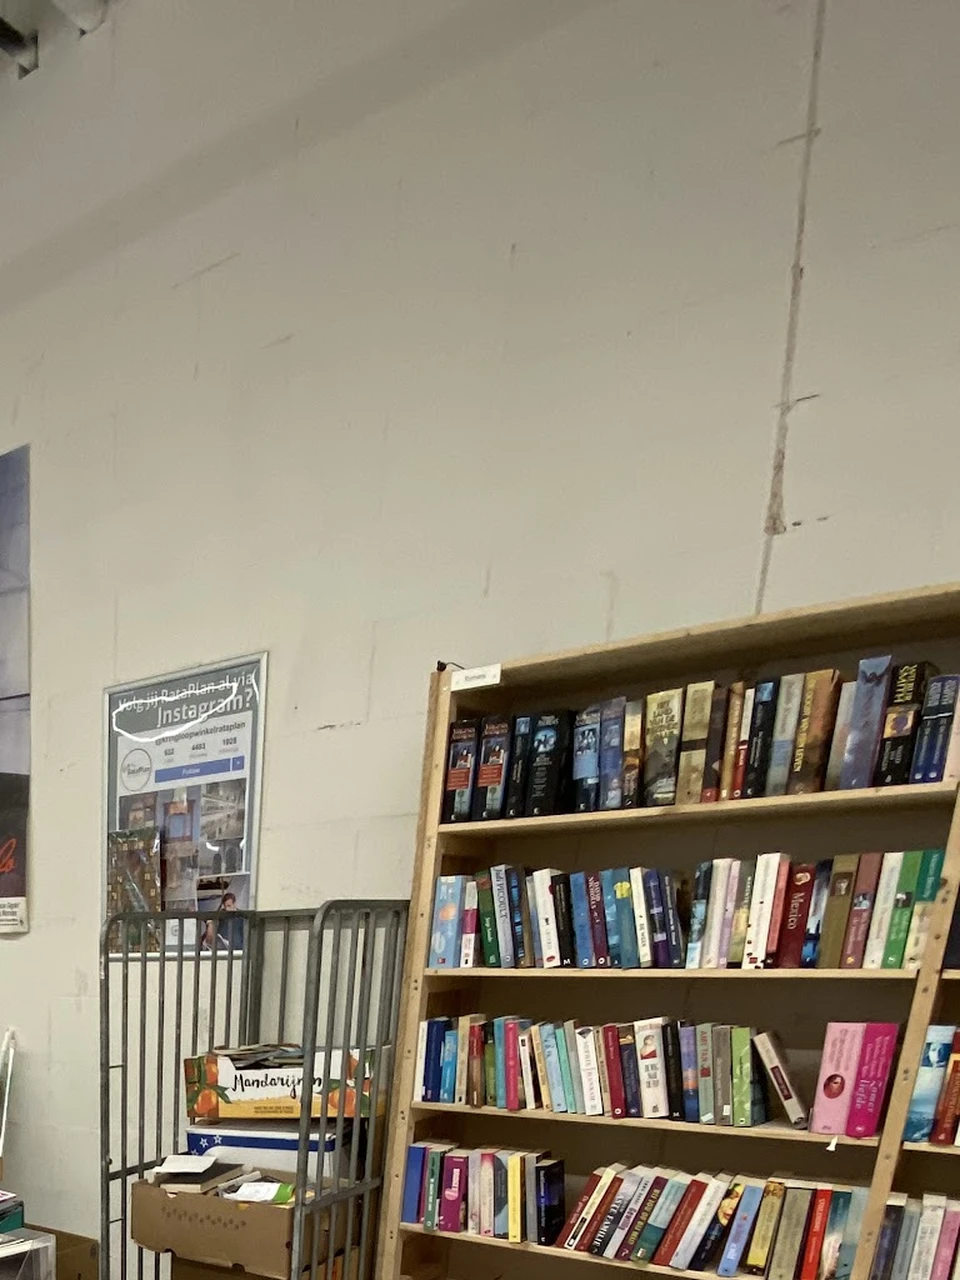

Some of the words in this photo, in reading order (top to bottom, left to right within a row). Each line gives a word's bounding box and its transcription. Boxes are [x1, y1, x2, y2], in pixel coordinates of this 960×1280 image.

[236, 672, 253, 687] via
[892, 664, 910, 705] SMITH
[157, 688, 252, 727] Instagram?
[793, 747, 805, 774] LEVEN
[498, 883, 508, 919] PICOULT
[787, 892, 805, 930] Mexico
[700, 1048, 709, 1062] TAN
[592, 1214, 615, 1248] FAMILIE
